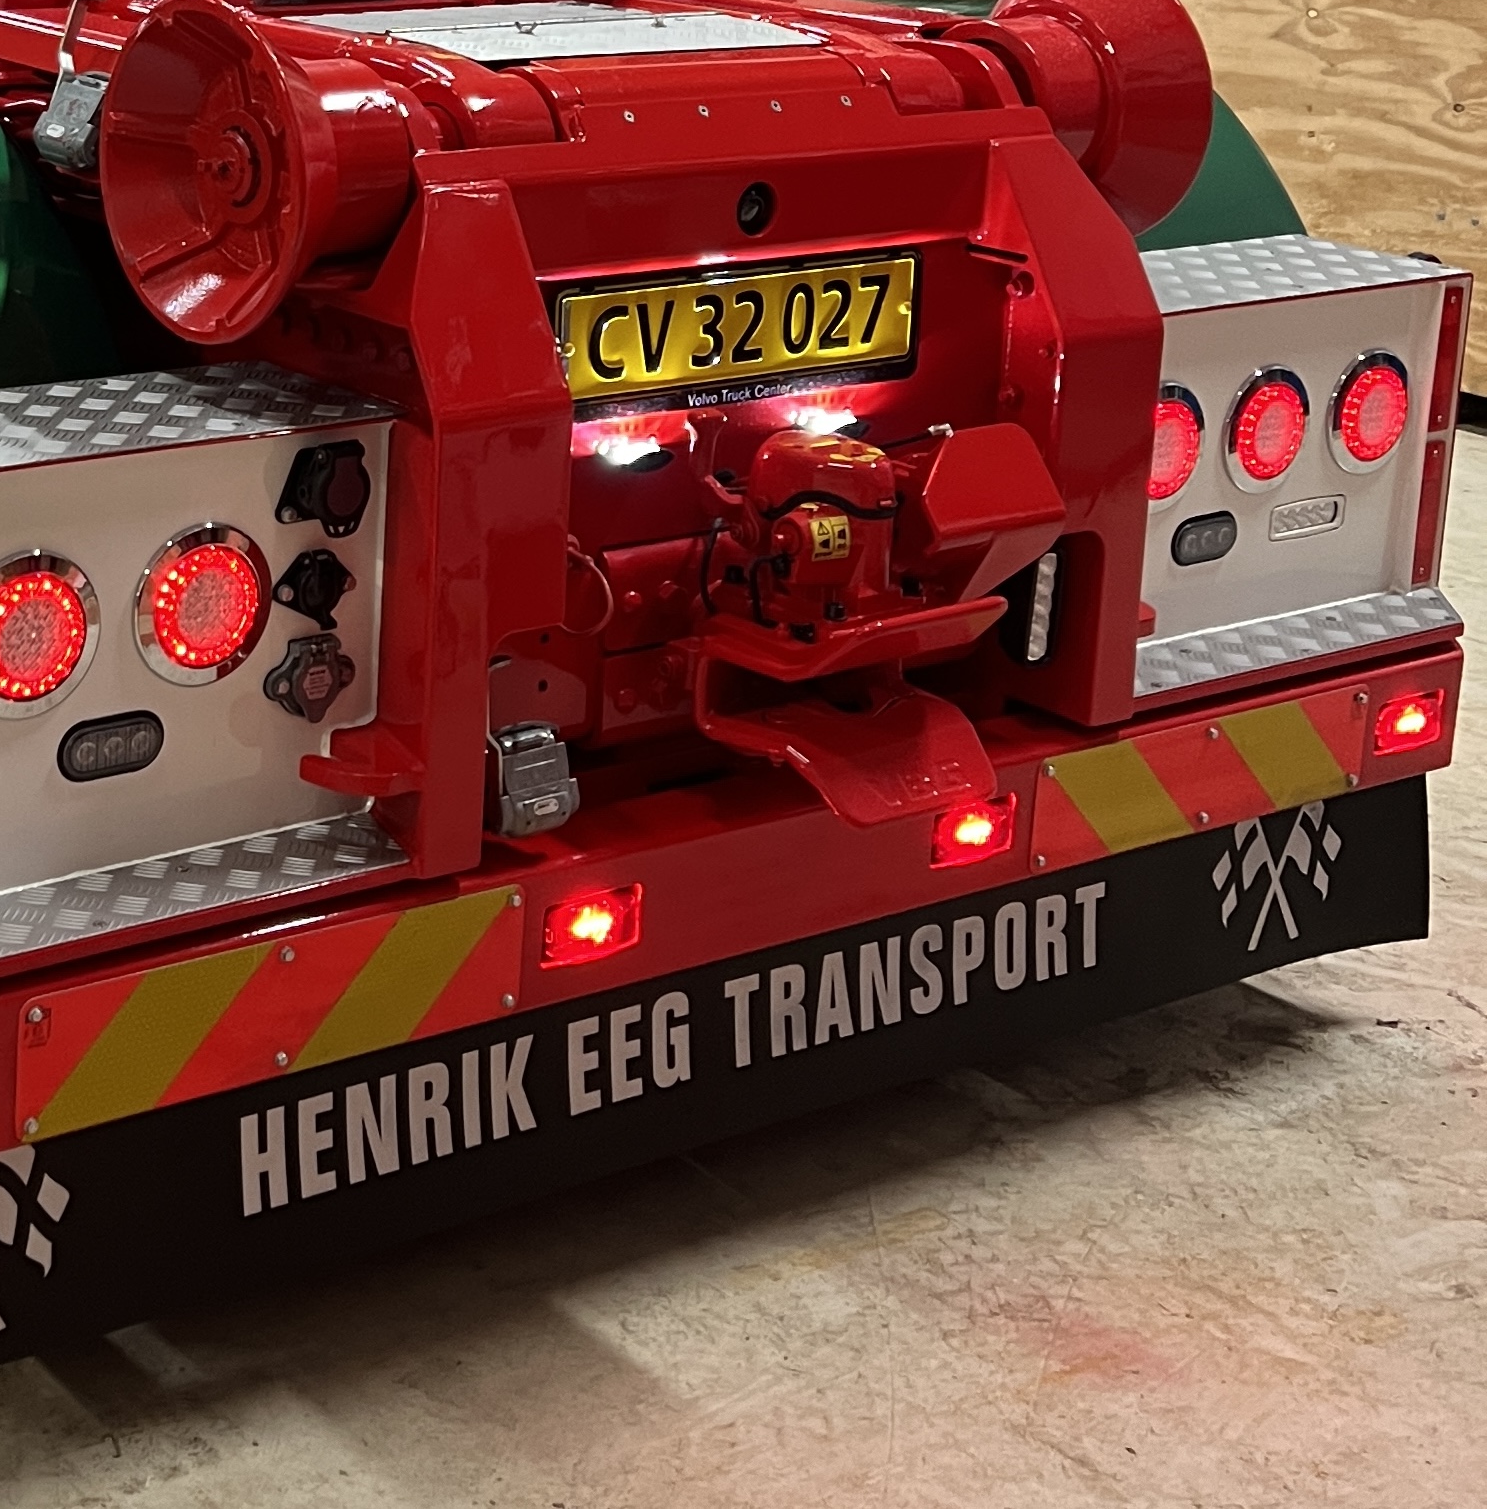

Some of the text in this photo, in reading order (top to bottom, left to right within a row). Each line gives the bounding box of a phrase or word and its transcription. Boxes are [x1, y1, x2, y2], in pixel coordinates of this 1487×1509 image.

[588, 274, 891, 382] CV 32 027
[687, 384, 793, 407] Volvo Truck Center
[240, 881, 1107, 1218] HENRIK EEG TRANSPORT
